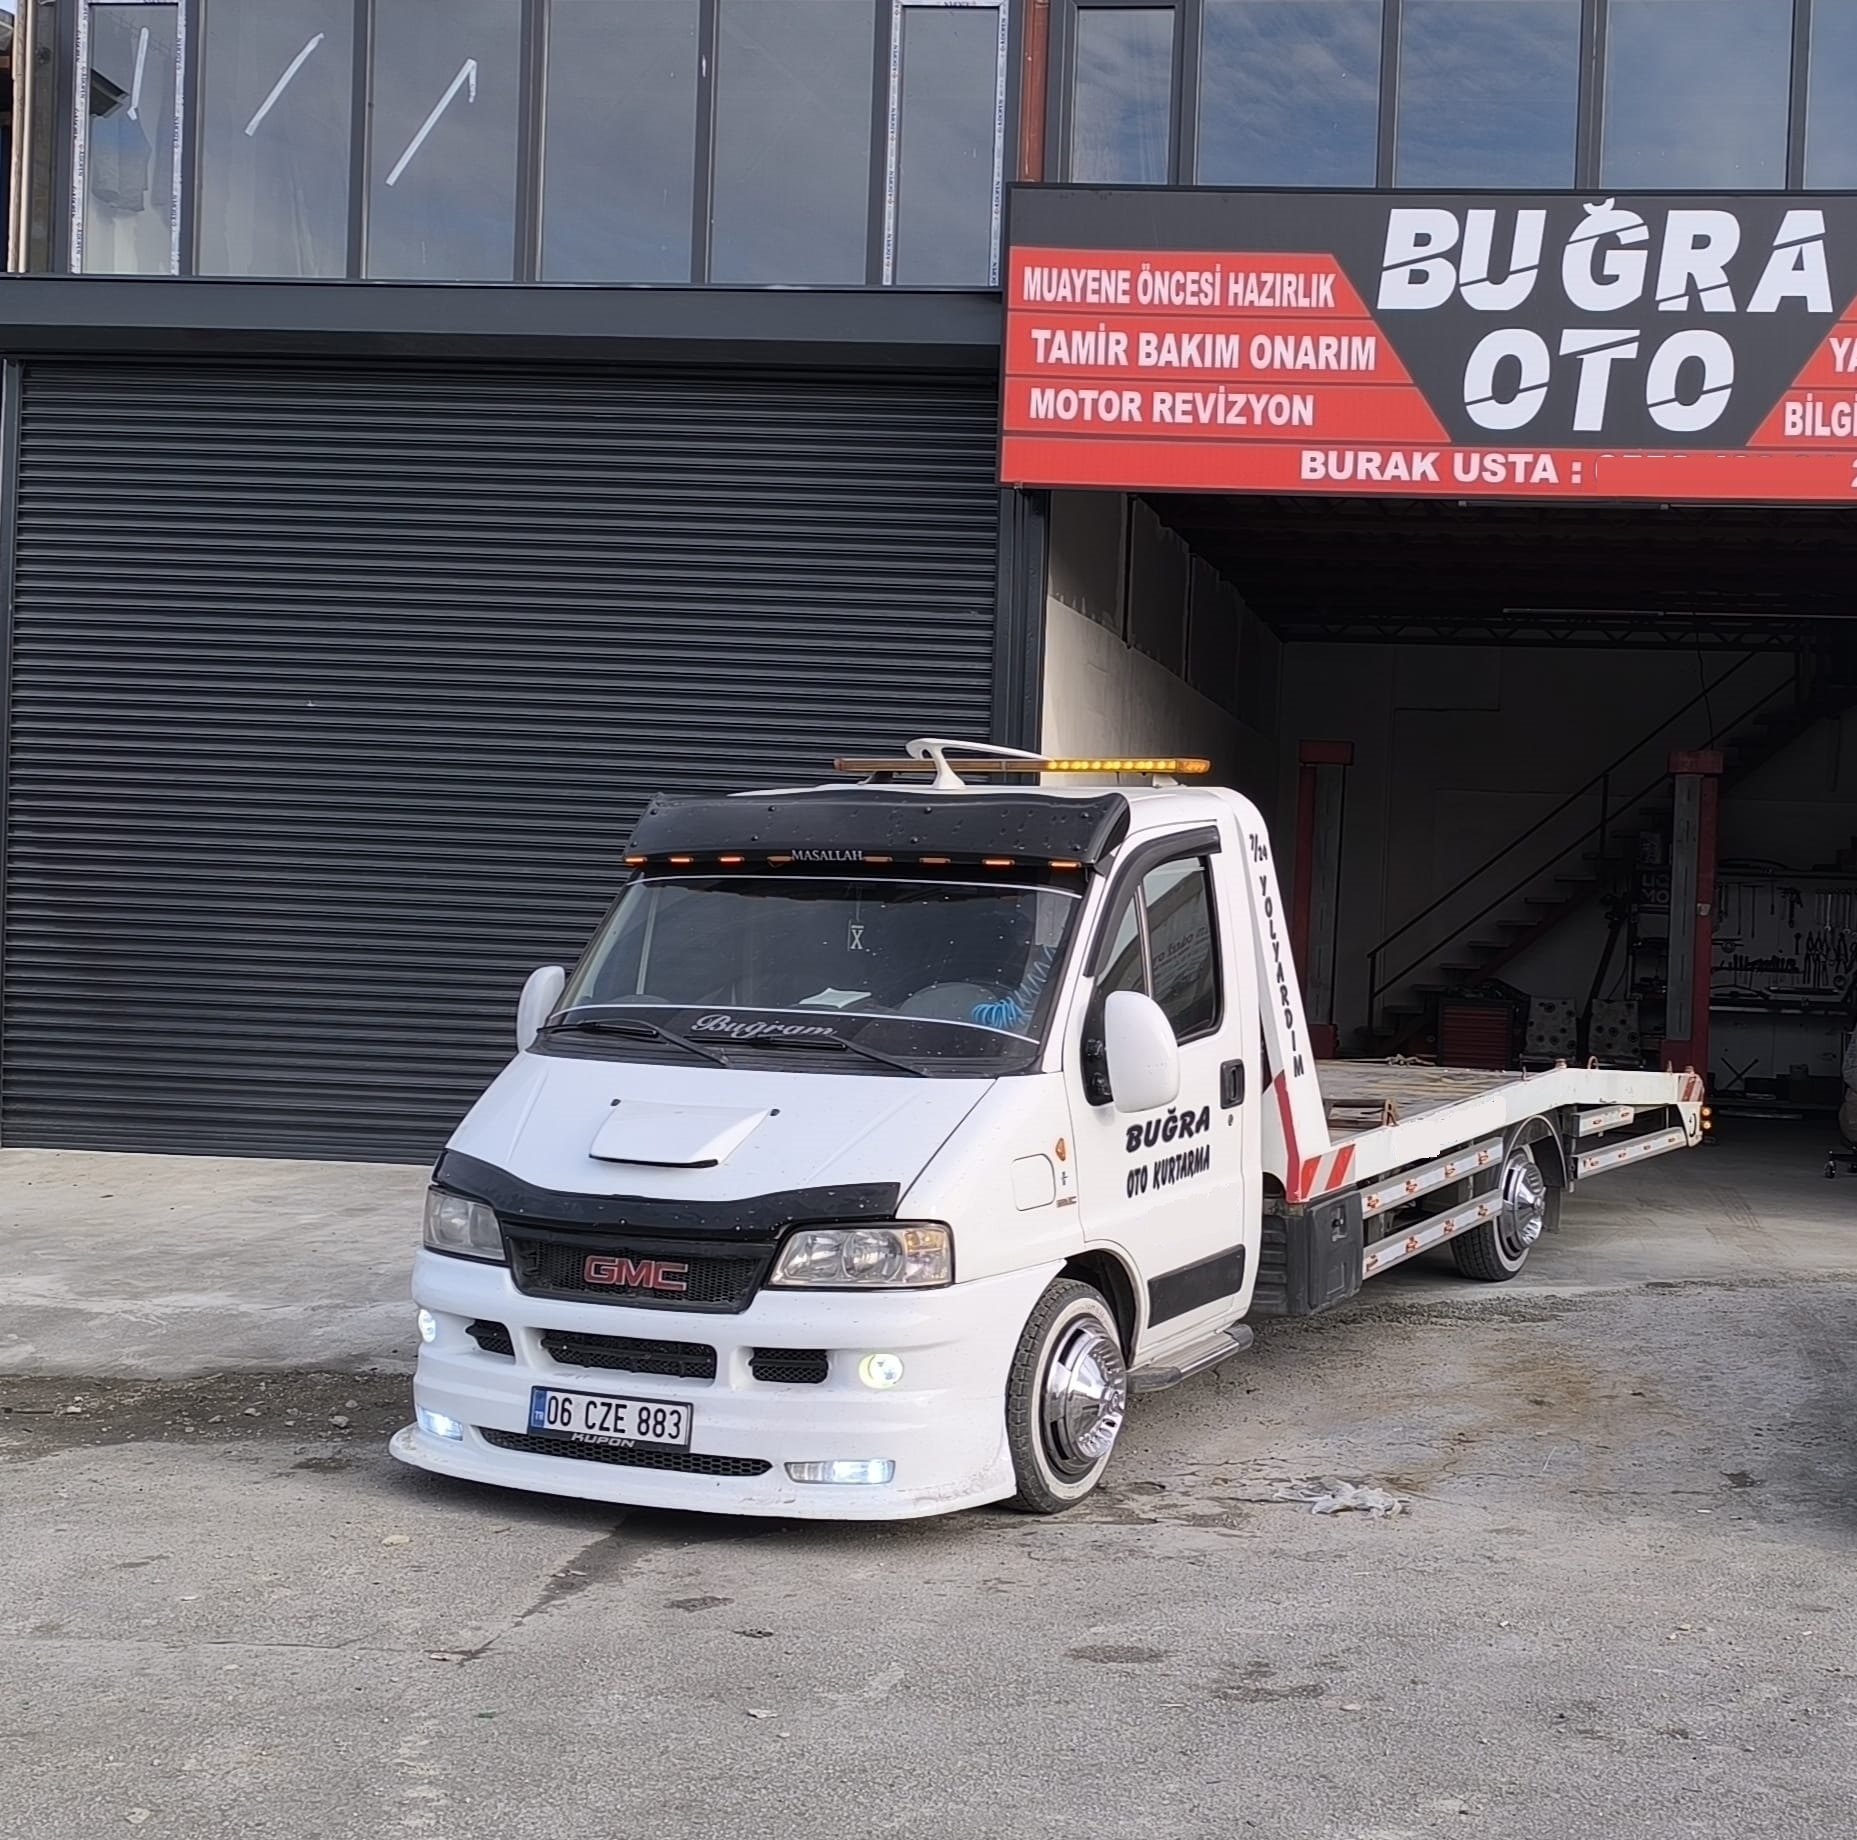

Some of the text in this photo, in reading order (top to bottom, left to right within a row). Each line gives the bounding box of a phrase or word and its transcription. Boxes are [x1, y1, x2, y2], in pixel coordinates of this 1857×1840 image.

[1377, 197, 1833, 313] BUĞRA
[1023, 263, 1336, 308] MUAYENE ÖNCESİ HAZIRLIK
[1031, 322, 1376, 371] TAMİR BAKIM ONARIM
[1463, 328, 1735, 432] OTO
[1029, 385, 1314, 426] MOTOR REVİZYON
[1301, 450, 1440, 482] BURAK
[1453, 452, 1559, 484] USTA
[791, 849, 863, 861] MASALLAH
[1249, 834, 1268, 862] 7/24
[1126, 1105, 1210, 1153] BUĞRA
[1127, 1144, 1210, 1198] OTO KURTARMA
[583, 1255, 689, 1291] GMC
[547, 1395, 682, 1440] 06 CZE 883
[571, 1432, 635, 1448] KUPON
